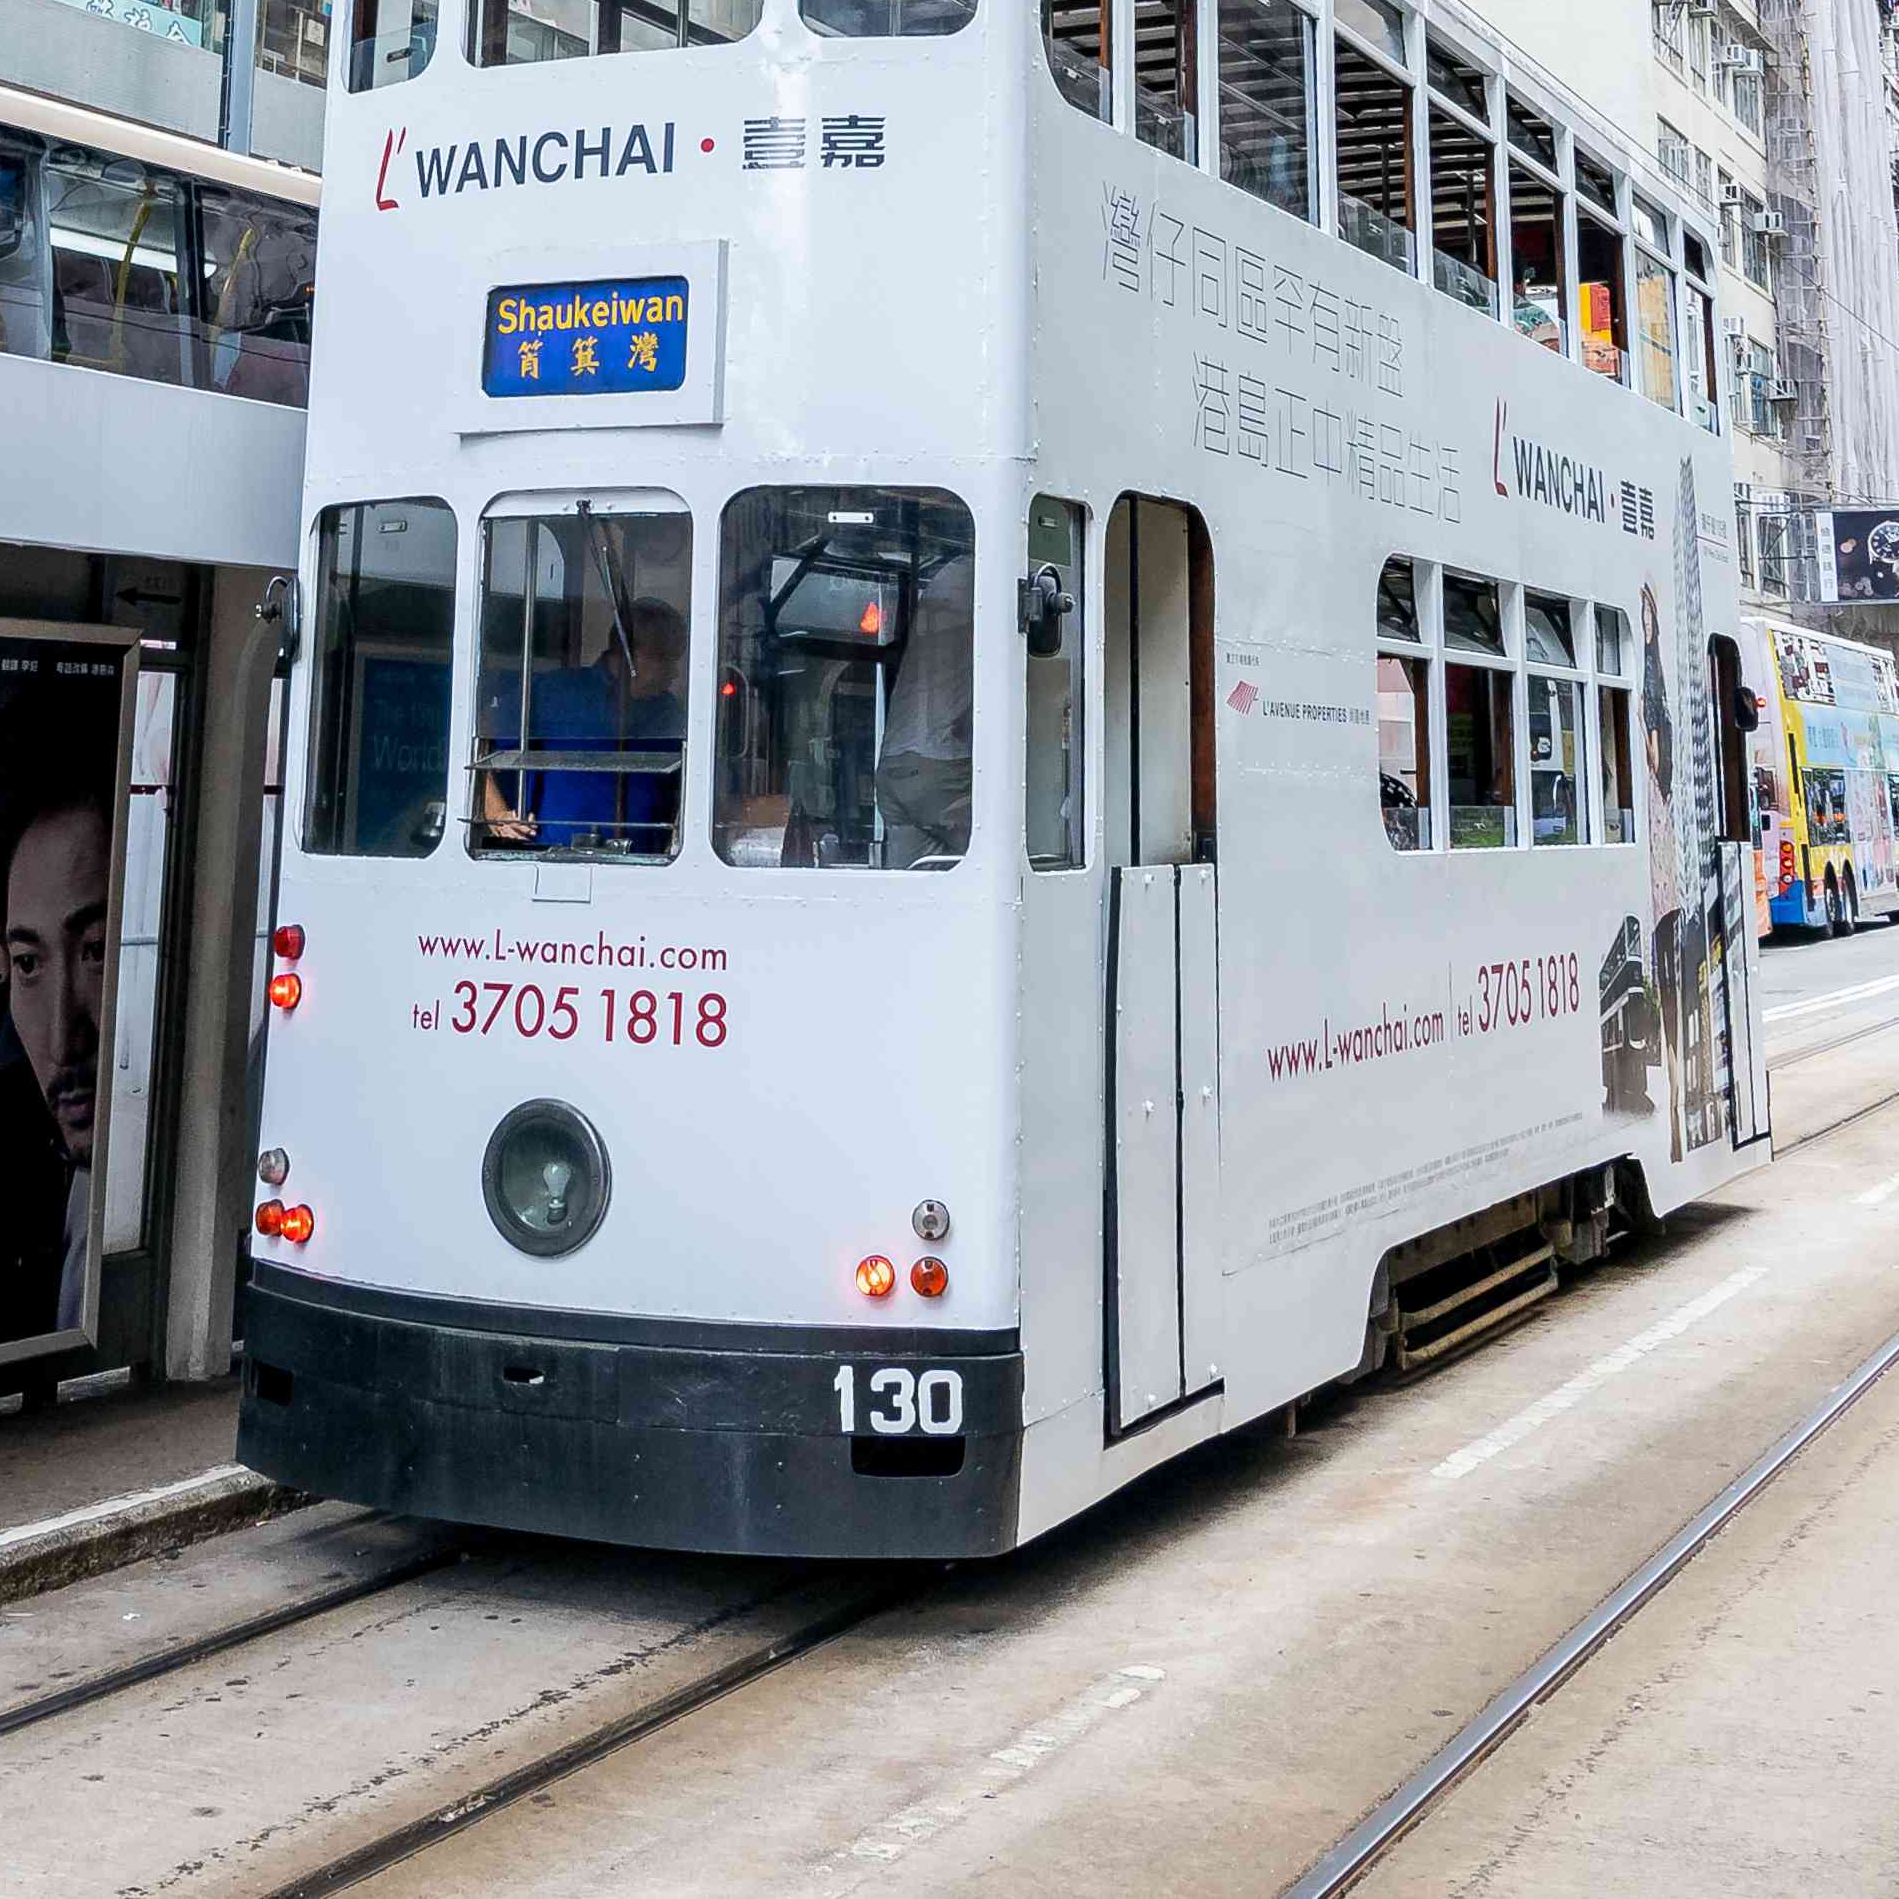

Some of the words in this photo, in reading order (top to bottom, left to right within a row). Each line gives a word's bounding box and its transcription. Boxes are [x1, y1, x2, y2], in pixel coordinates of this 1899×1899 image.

[415, 122, 676, 199] WANCHAI
[497, 291, 684, 335] Shaukeiwan
[1100, 179, 1404, 399] 灣仔同區罕有新盤
[517, 332, 660, 381] 筲箕灣
[1193, 350, 1462, 525] 港島正中精品生活
[1512, 435, 1606, 524] WANCHAI
[1302, 704, 1347, 724] PROPERTIES
[417, 928, 727, 971] www.L-wanchai.com
[413, 999, 440, 1031] tel
[451, 980, 580, 1040] 3705
[600, 988, 727, 1048] 1818
[1267, 1002, 1444, 1083] www.L-wanchai.com
[1458, 994, 1473, 1037] tel
[1478, 959, 1532, 1032] 3705
[1537, 952, 1579, 1019] 1818
[832, 1364, 965, 1436] 130
